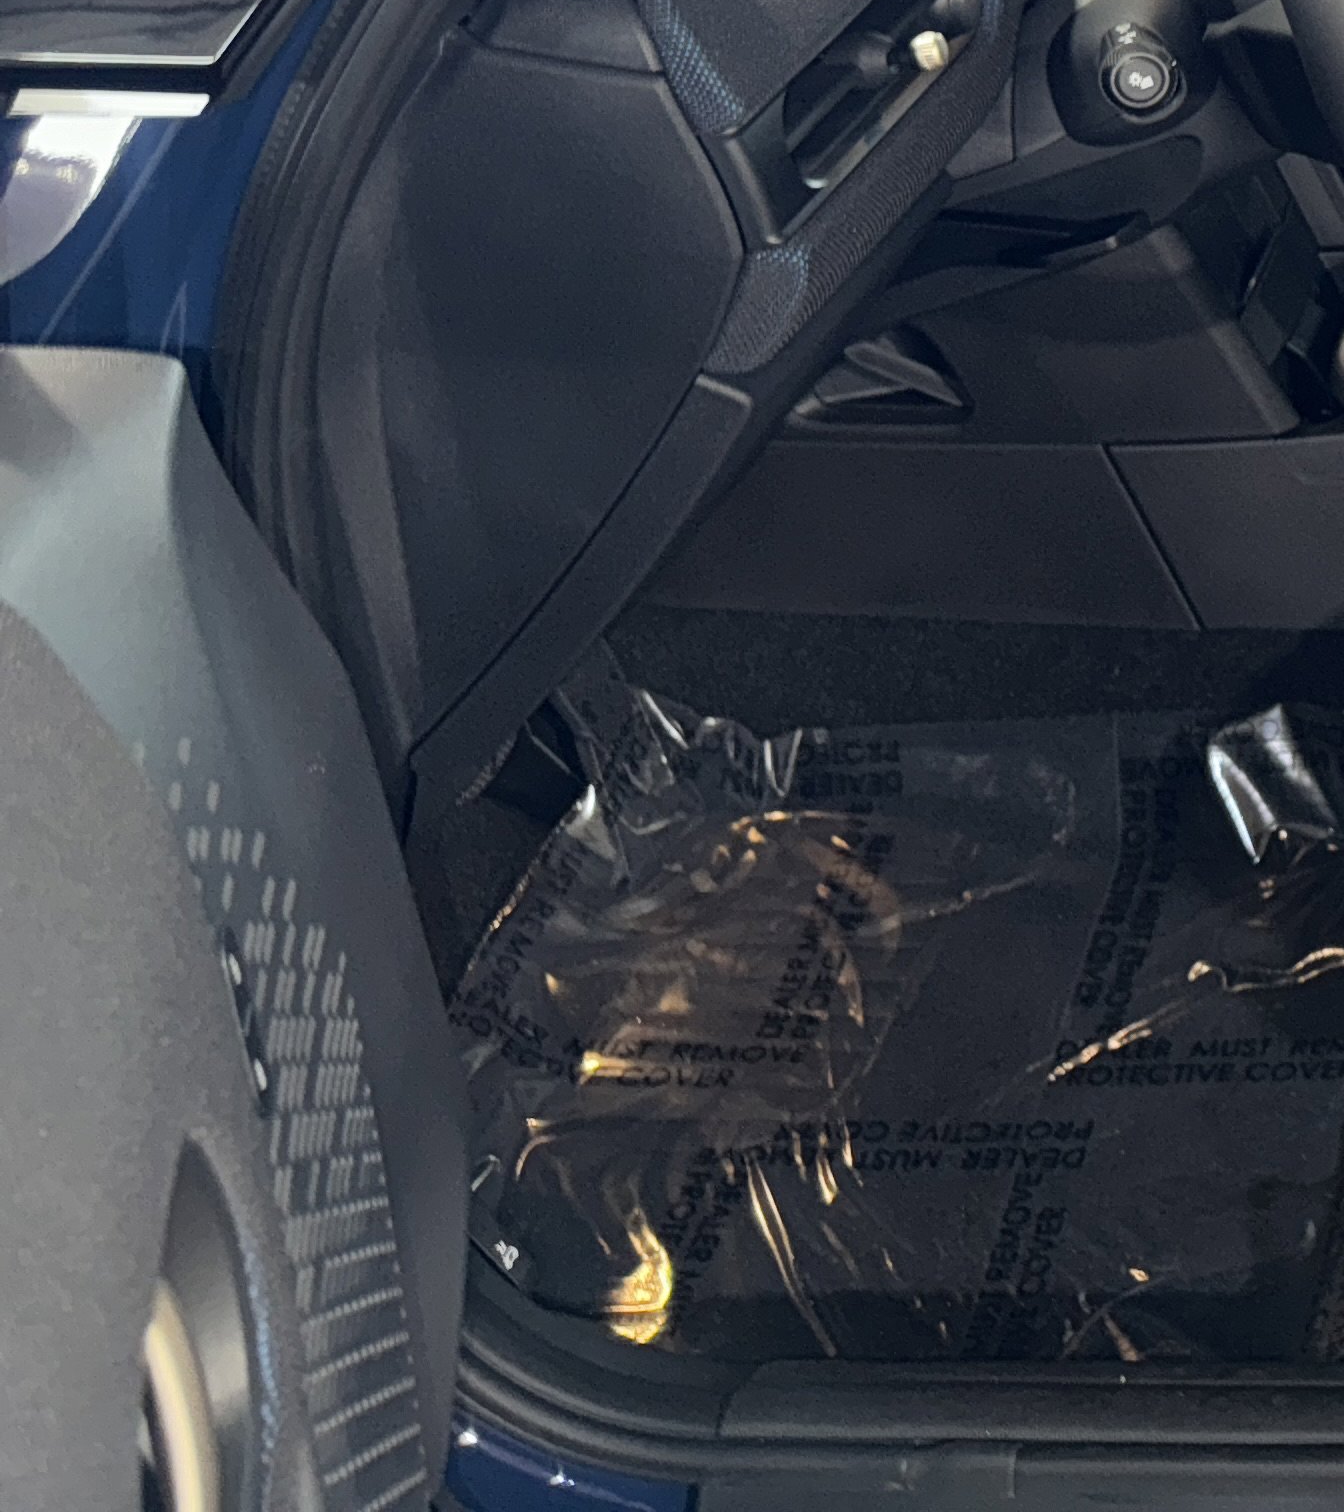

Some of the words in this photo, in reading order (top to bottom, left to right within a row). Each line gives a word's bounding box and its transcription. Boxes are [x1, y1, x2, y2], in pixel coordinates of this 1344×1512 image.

[1189, 1037, 1274, 1059] MUST
[896, 1118, 1095, 1144] PROTECTIVE
[959, 1145, 1087, 1173] DEALER
